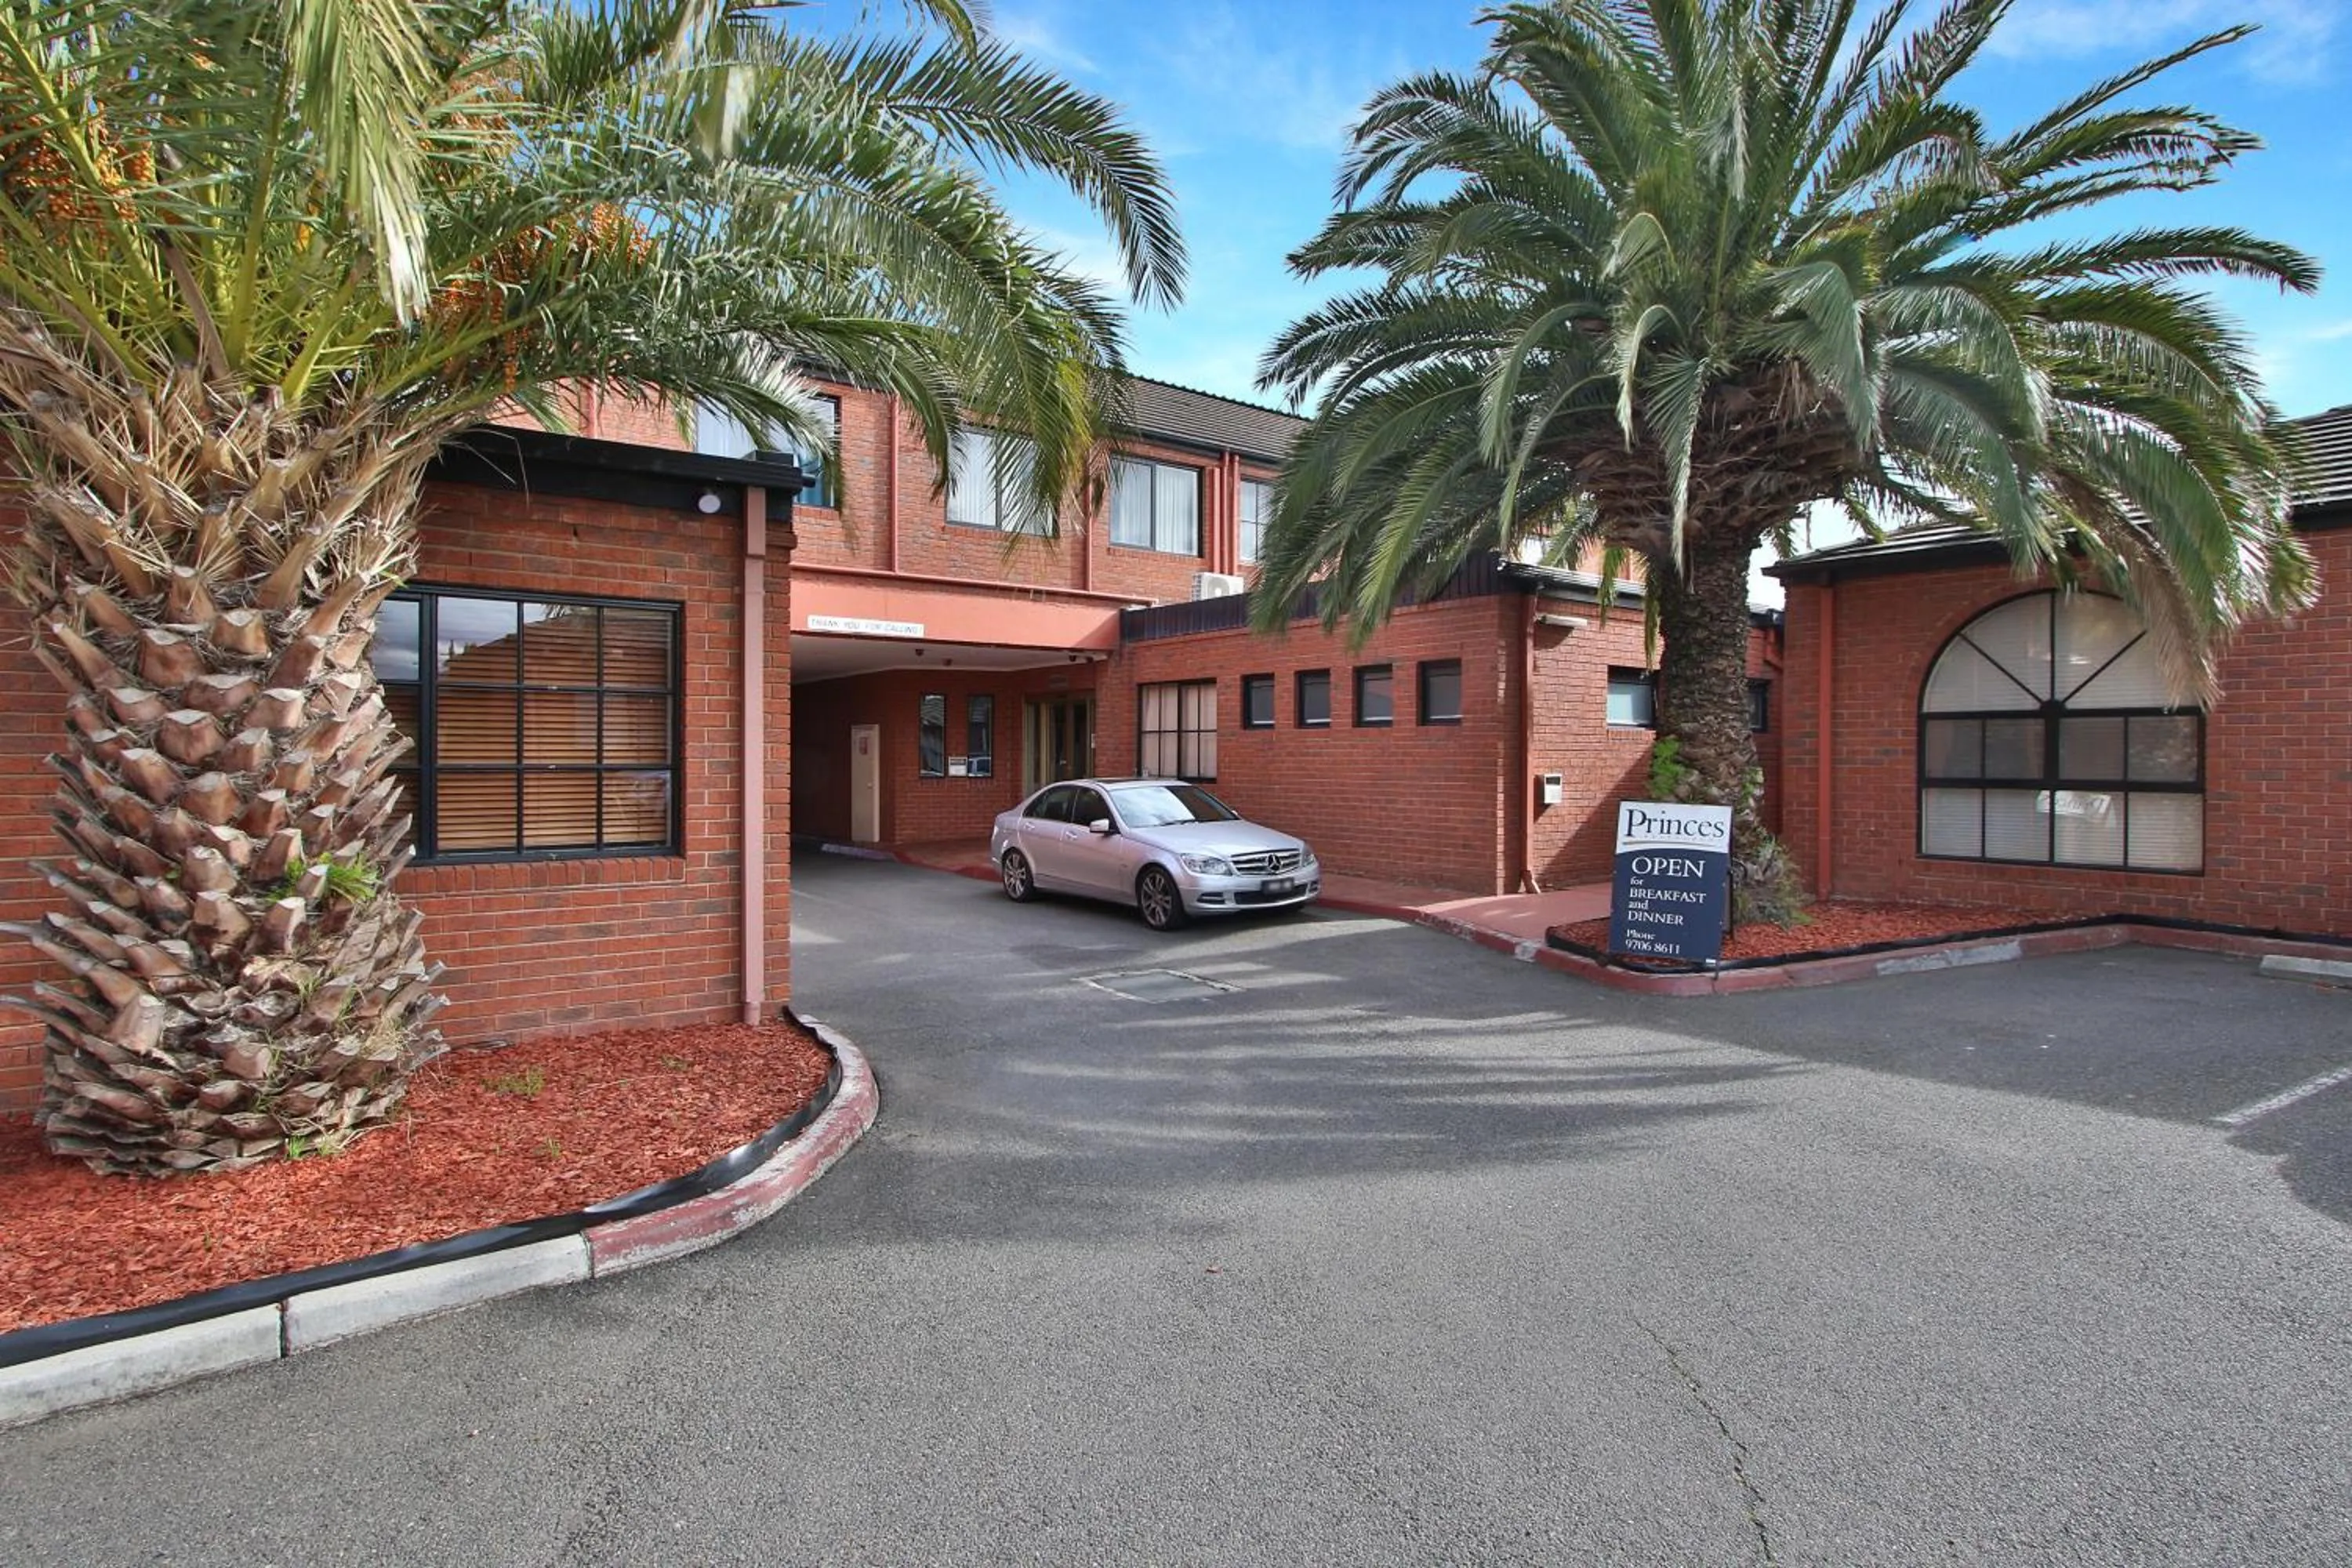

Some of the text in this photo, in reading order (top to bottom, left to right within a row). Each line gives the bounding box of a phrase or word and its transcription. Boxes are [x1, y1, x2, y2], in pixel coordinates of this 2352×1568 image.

[811, 618, 840, 628] THANK
[844, 621, 860, 630] YOU
[1625, 808, 1724, 838] Princes
[1632, 856, 1706, 878] OPEN
[1631, 876, 1644, 885] for
[1630, 887, 1707, 904] BREAKFAST
[1628, 899, 1649, 909] and
[1628, 910, 1684, 926] DINNER
[1627, 928, 1656, 940] Phone
[1625, 938, 1681, 954] 9706 8611
